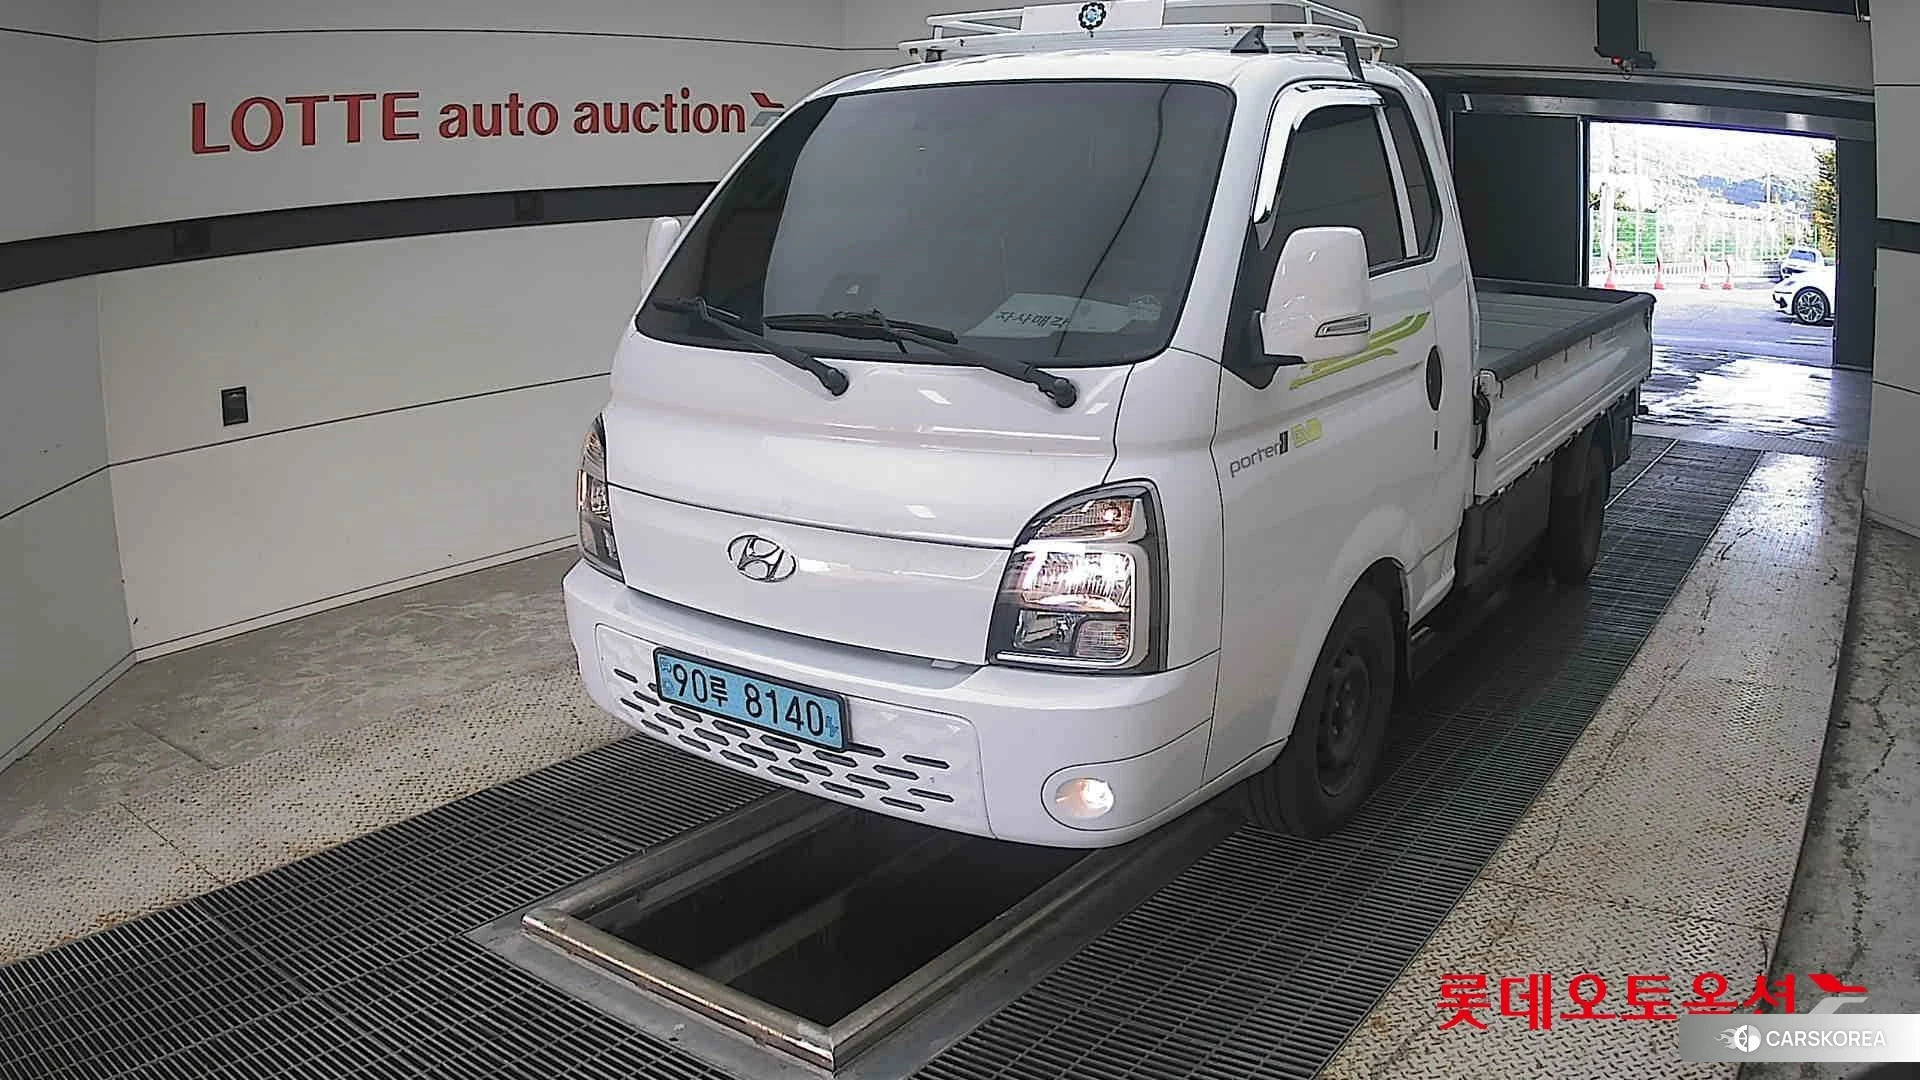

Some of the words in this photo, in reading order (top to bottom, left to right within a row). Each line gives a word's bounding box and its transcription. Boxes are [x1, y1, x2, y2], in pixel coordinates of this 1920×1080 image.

[191, 92, 419, 155] LOTTE
[438, 91, 559, 139] auto
[573, 87, 747, 136] auction
[672, 663, 729, 708] 90루
[744, 683, 824, 737] 8140
